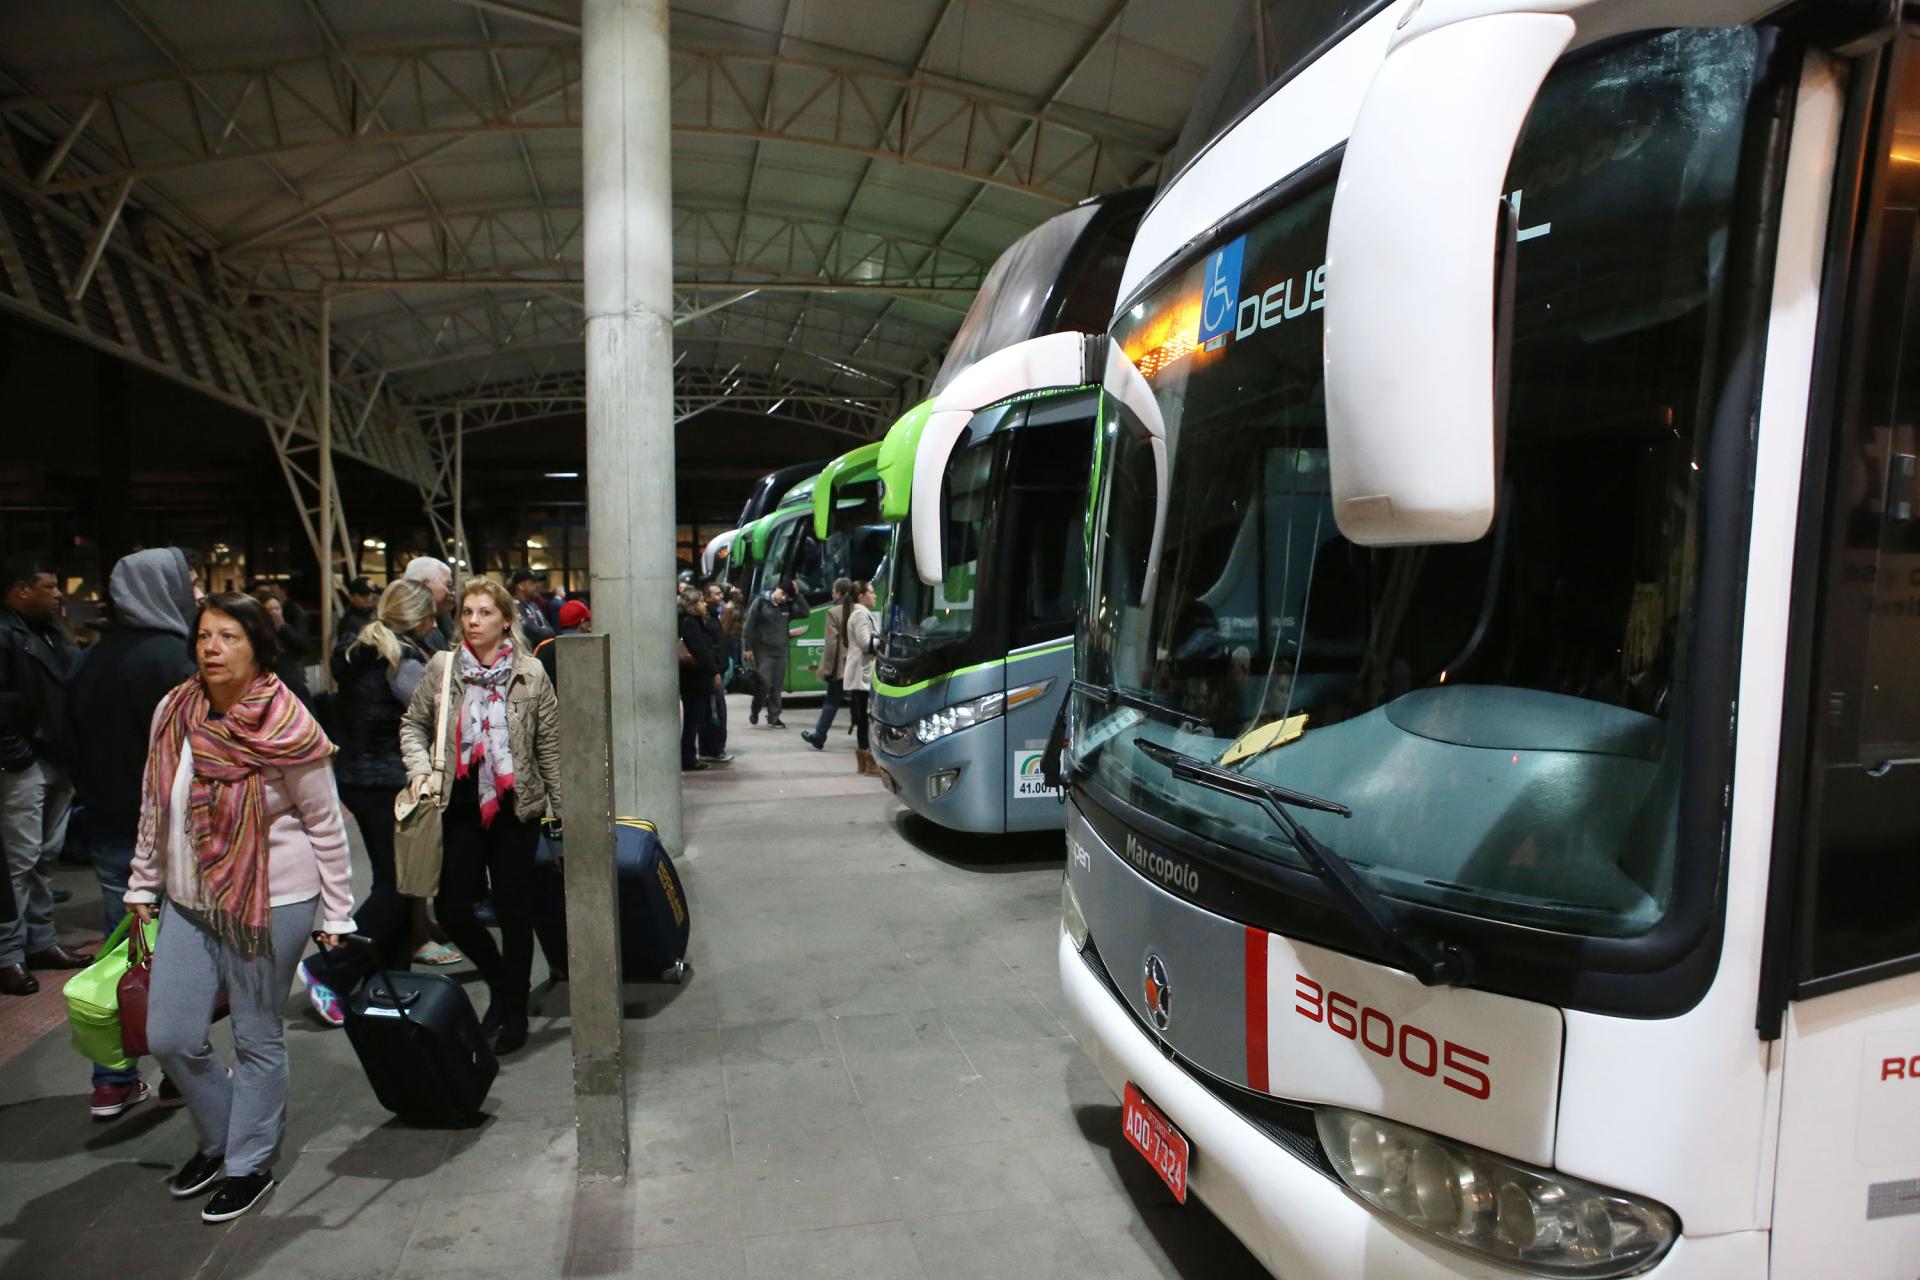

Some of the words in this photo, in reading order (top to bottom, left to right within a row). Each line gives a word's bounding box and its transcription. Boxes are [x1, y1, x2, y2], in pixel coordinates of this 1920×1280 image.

[1236, 264, 1327, 341] DEUS
[1126, 833, 1199, 894] Marcopolo
[1295, 973, 1491, 1101] 36005
